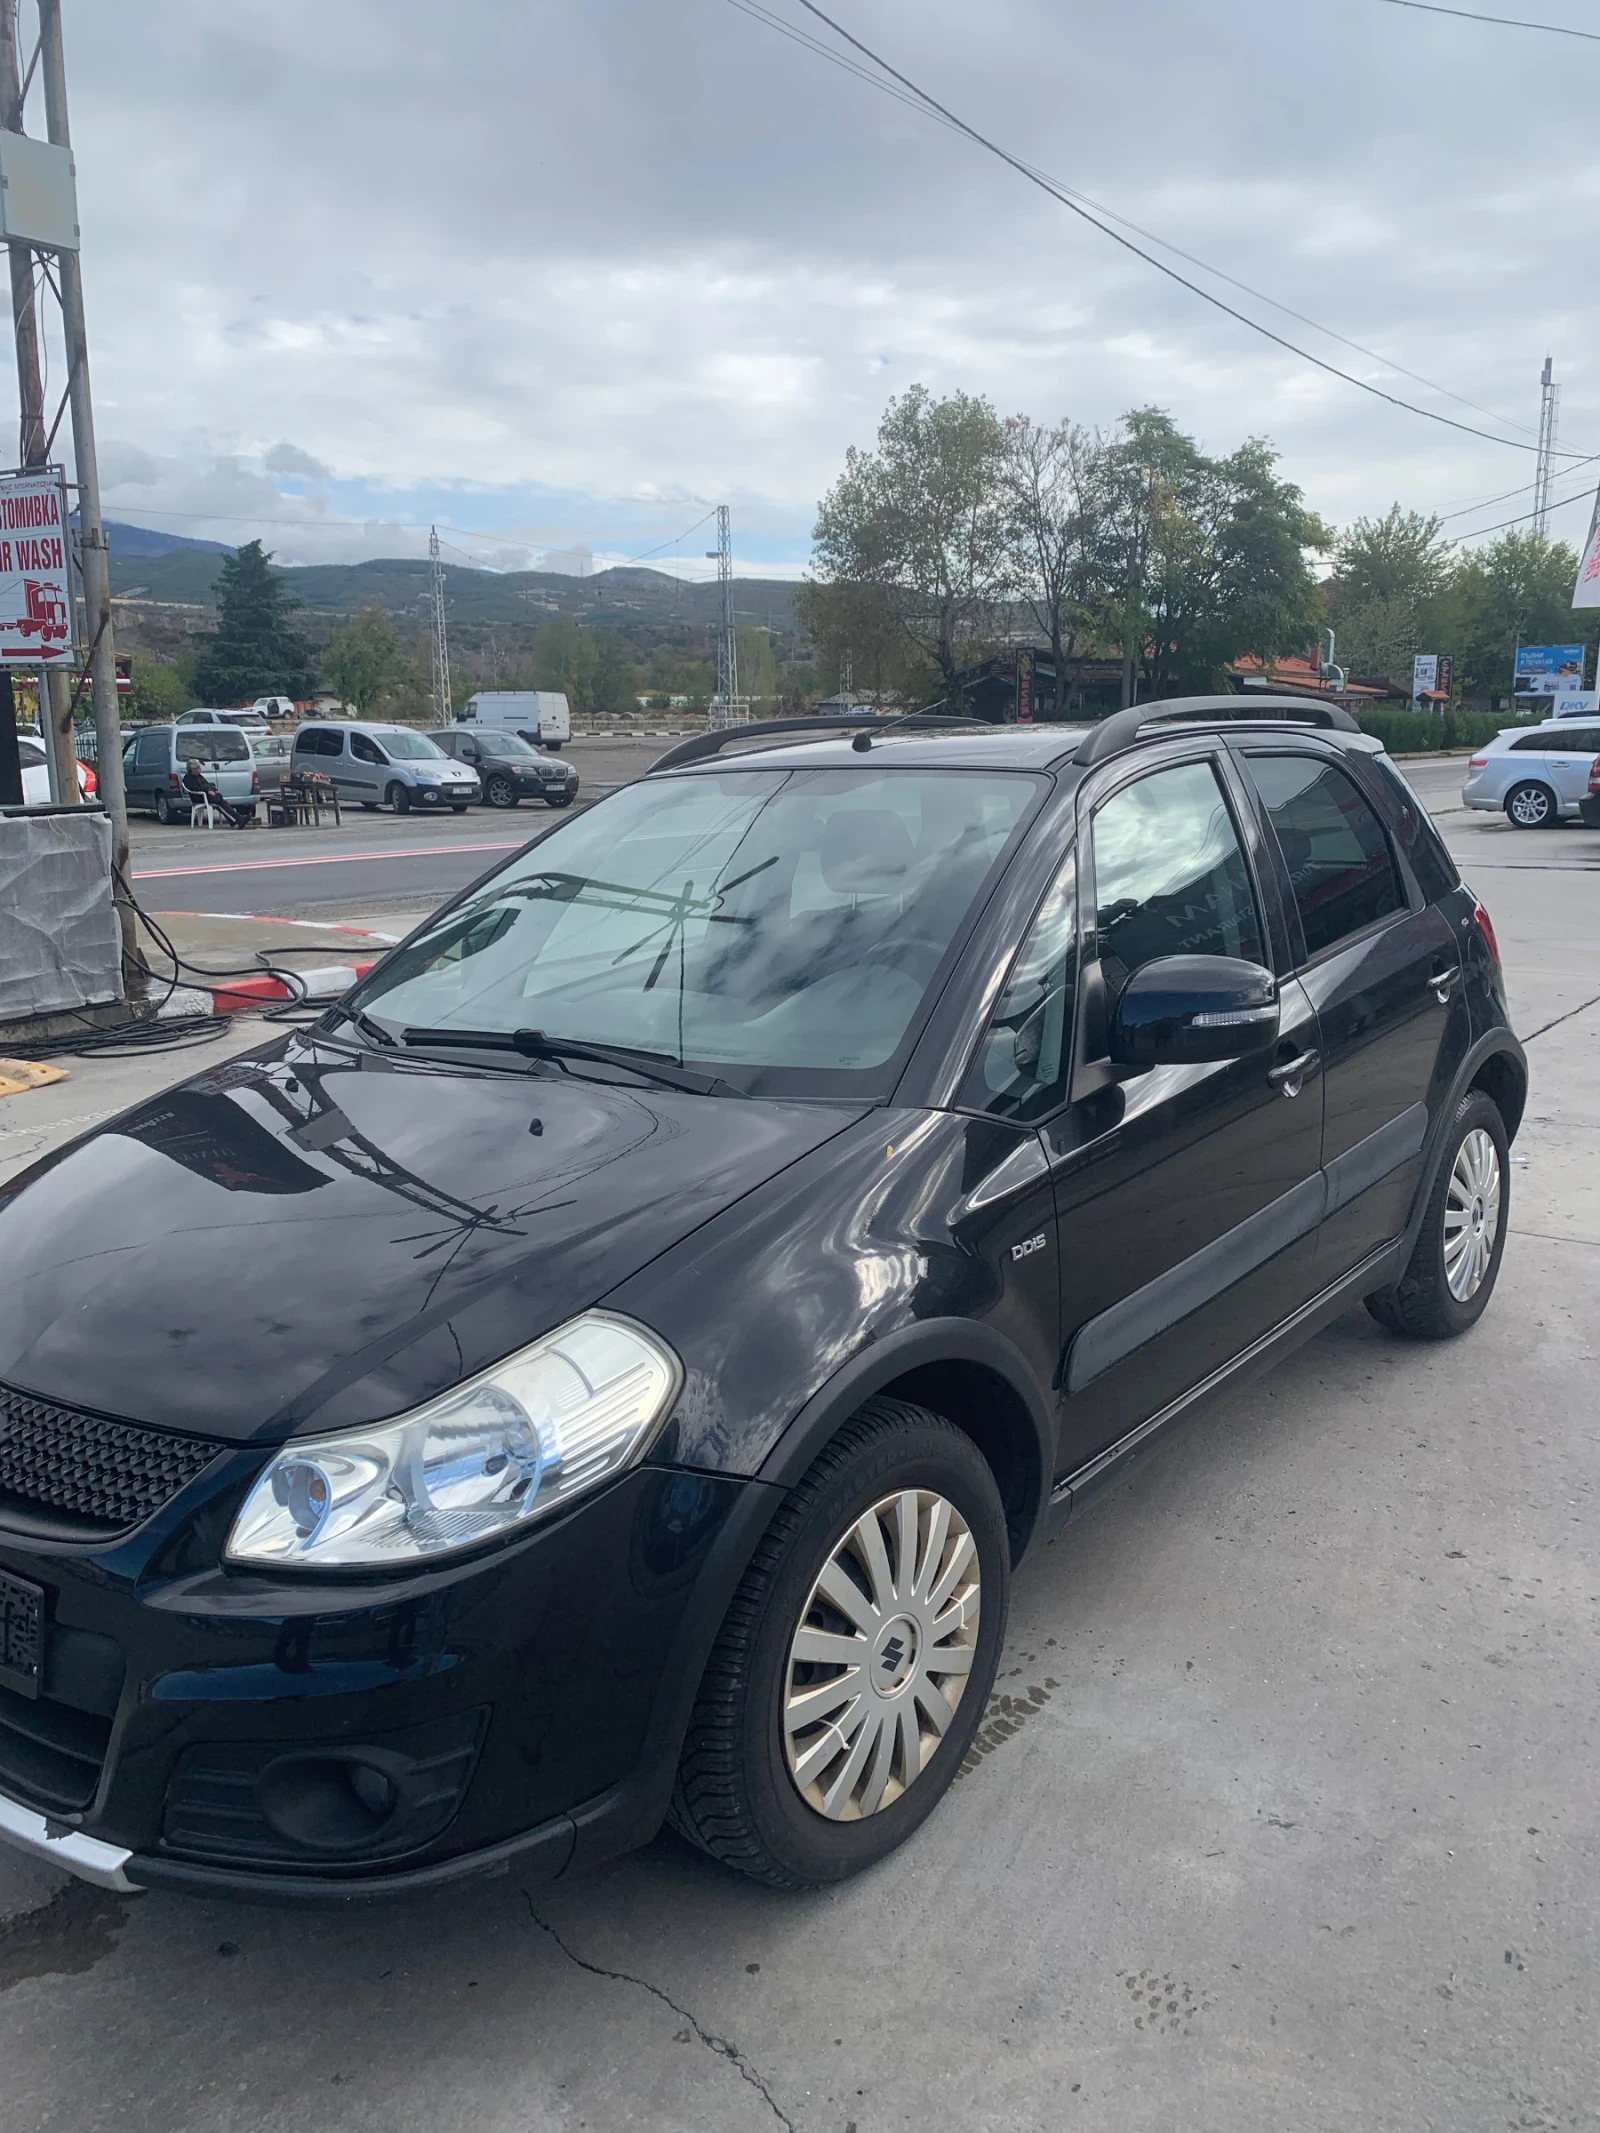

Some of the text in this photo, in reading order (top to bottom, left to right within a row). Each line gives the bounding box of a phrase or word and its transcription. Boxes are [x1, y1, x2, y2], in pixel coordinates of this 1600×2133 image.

[0, 494, 60, 530] ТОМИВКА
[15, 538, 63, 571] WASH
[1560, 701, 1589, 711] DKV
